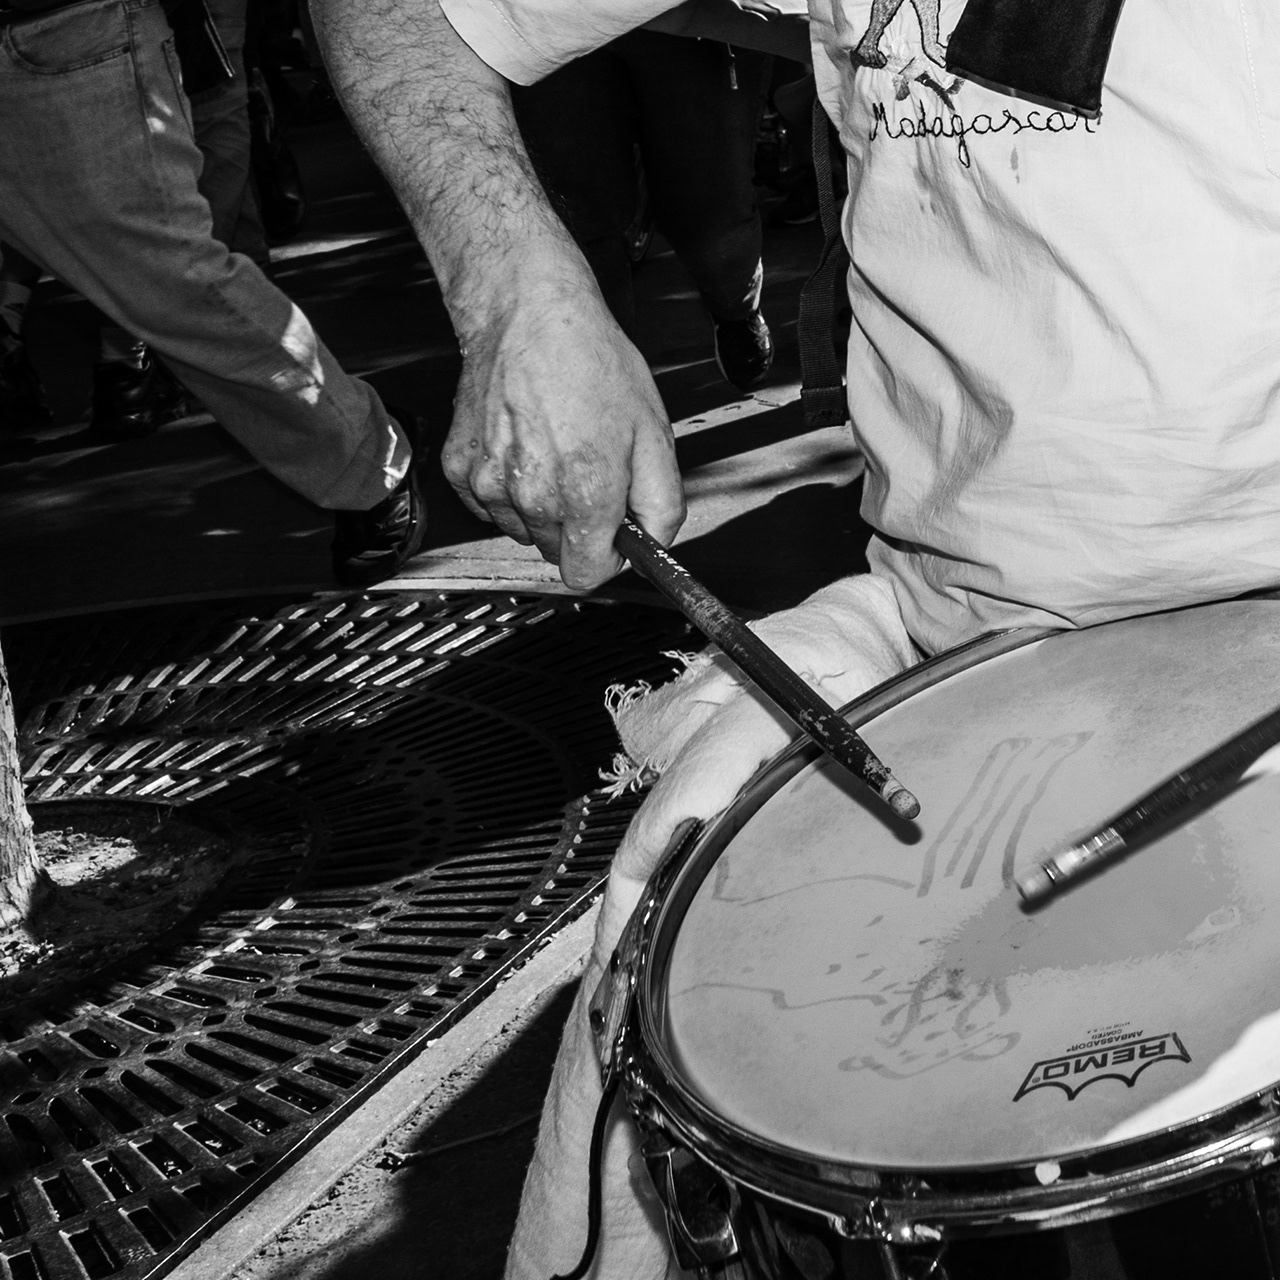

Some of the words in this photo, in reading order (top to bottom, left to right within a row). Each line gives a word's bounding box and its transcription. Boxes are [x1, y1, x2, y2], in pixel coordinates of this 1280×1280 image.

[869, 99, 1096, 168] Madagascar
[1092, 1029, 1122, 1039] COATED
[1042, 1040, 1166, 1080] REMO
